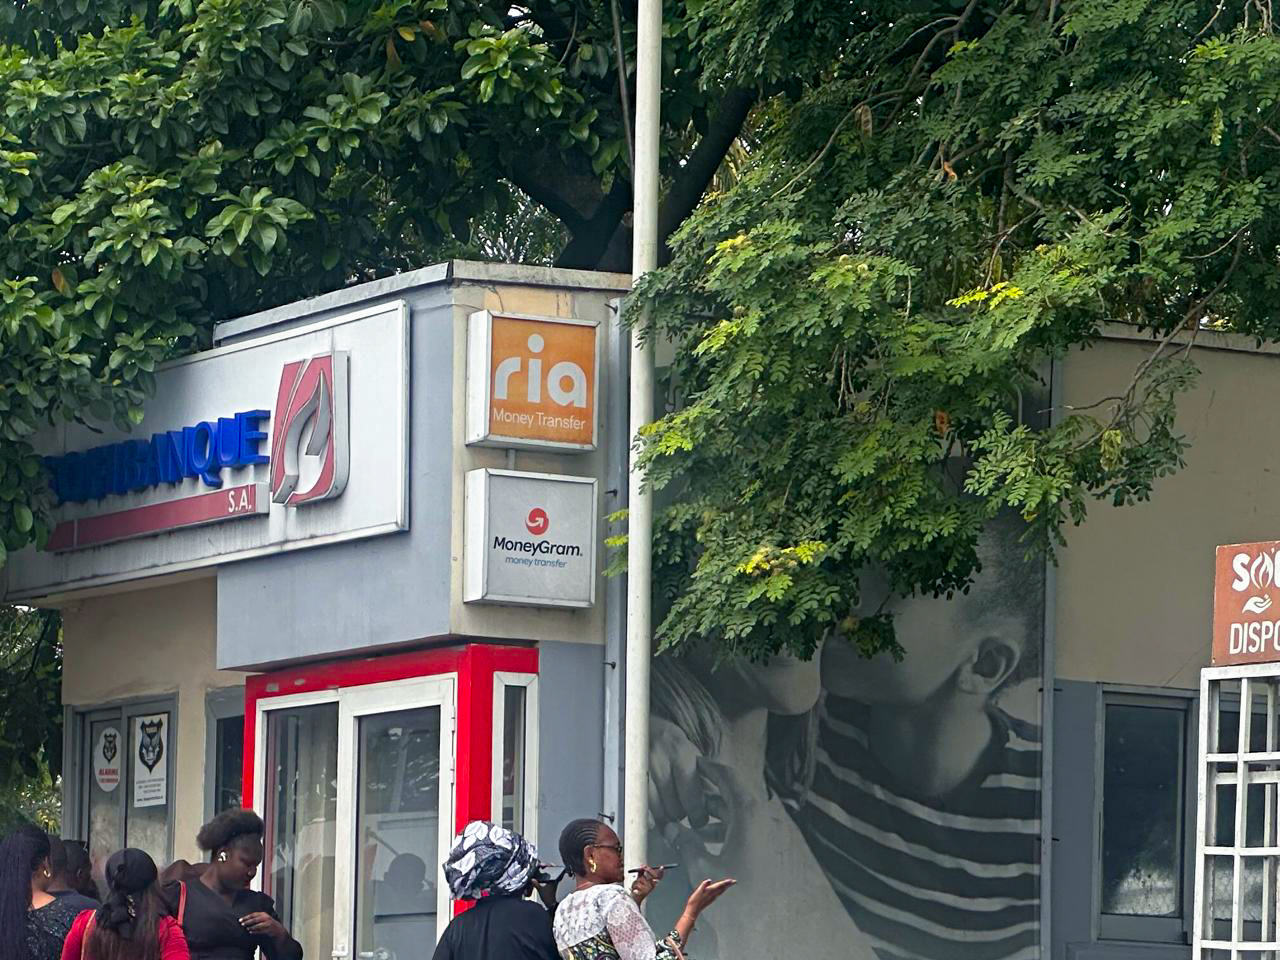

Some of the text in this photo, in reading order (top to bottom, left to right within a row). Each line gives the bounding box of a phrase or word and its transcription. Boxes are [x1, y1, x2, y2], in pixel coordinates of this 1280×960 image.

[494, 333, 588, 408] ria
[493, 408, 586, 430] Money Transfer
[228, 490, 252, 513] S.A.
[505, 556, 567, 568] money transfer
